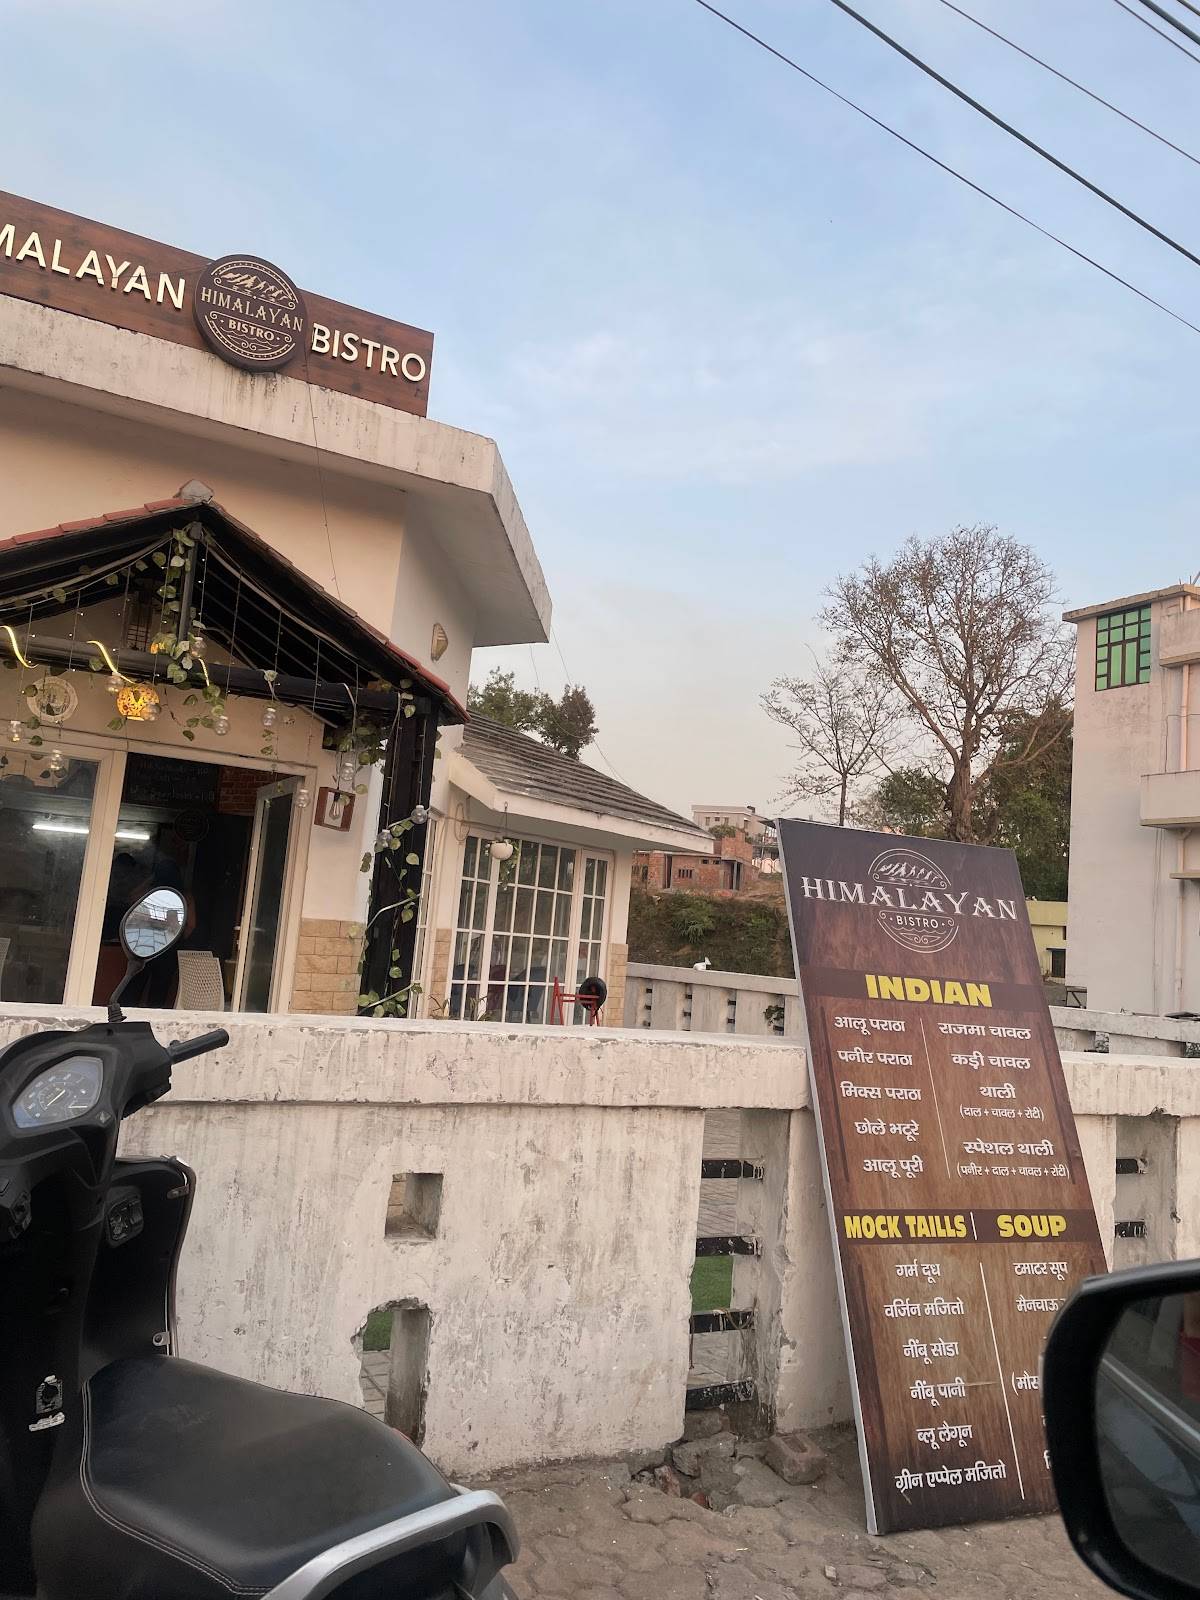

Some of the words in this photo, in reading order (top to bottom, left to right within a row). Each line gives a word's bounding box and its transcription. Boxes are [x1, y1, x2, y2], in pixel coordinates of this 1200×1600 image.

[201, 287, 303, 332] HIMALAYAN
[228, 319, 275, 341] BISTRO
[311, 322, 426, 383] BISTRO
[801, 876, 1018, 920] HIMALAYAN
[897, 915, 939, 929] BISTRO
[865, 974, 993, 1008] INDIAN
[834, 1016, 871, 1036] आलू
[869, 1018, 906, 1032] पराठा
[937, 1022, 986, 1036] राजमा
[988, 1026, 1032, 1040] चावल
[837, 1046, 874, 1064] पनीर
[876, 1052, 913, 1066] पराठा
[987, 1056, 1031, 1070] चावल
[840, 1080, 882, 1099] मिक्स
[884, 1087, 922, 1101] पराठा
[980, 1082, 1017, 1099] थाली
[991, 1108, 1016, 1119] चावल
[854, 1117, 887, 1136] छोले
[889, 1119, 920, 1142] भटूरे
[963, 1137, 1015, 1156] स्पेशल
[1017, 1139, 1055, 1157] थाली
[863, 1159, 901, 1179] आलू
[899, 1154, 924, 1179] पूरी
[991, 1166, 1010, 1177] दाल
[1018, 1166, 1042, 1177] चावल
[843, 1215, 902, 1239] MOCK
[904, 1214, 967, 1238] TAILLS
[996, 1214, 1067, 1238] SOUP
[895, 1258, 919, 1278] गर्म
[920, 1263, 941, 1284] दूध
[1012, 1262, 1048, 1276] टमाटर
[1048, 1261, 1069, 1281] सूप
[883, 1297, 921, 1318] वर्जिन
[923, 1296, 965, 1316] मजितो
[902, 1338, 933, 1365] नींबू
[929, 1337, 960, 1357] सोडा
[909, 1379, 940, 1407] नींबू
[937, 1376, 966, 1399] पानी
[895, 1468, 924, 1493] ग्रीन
[964, 1459, 1007, 1482] मजितो
